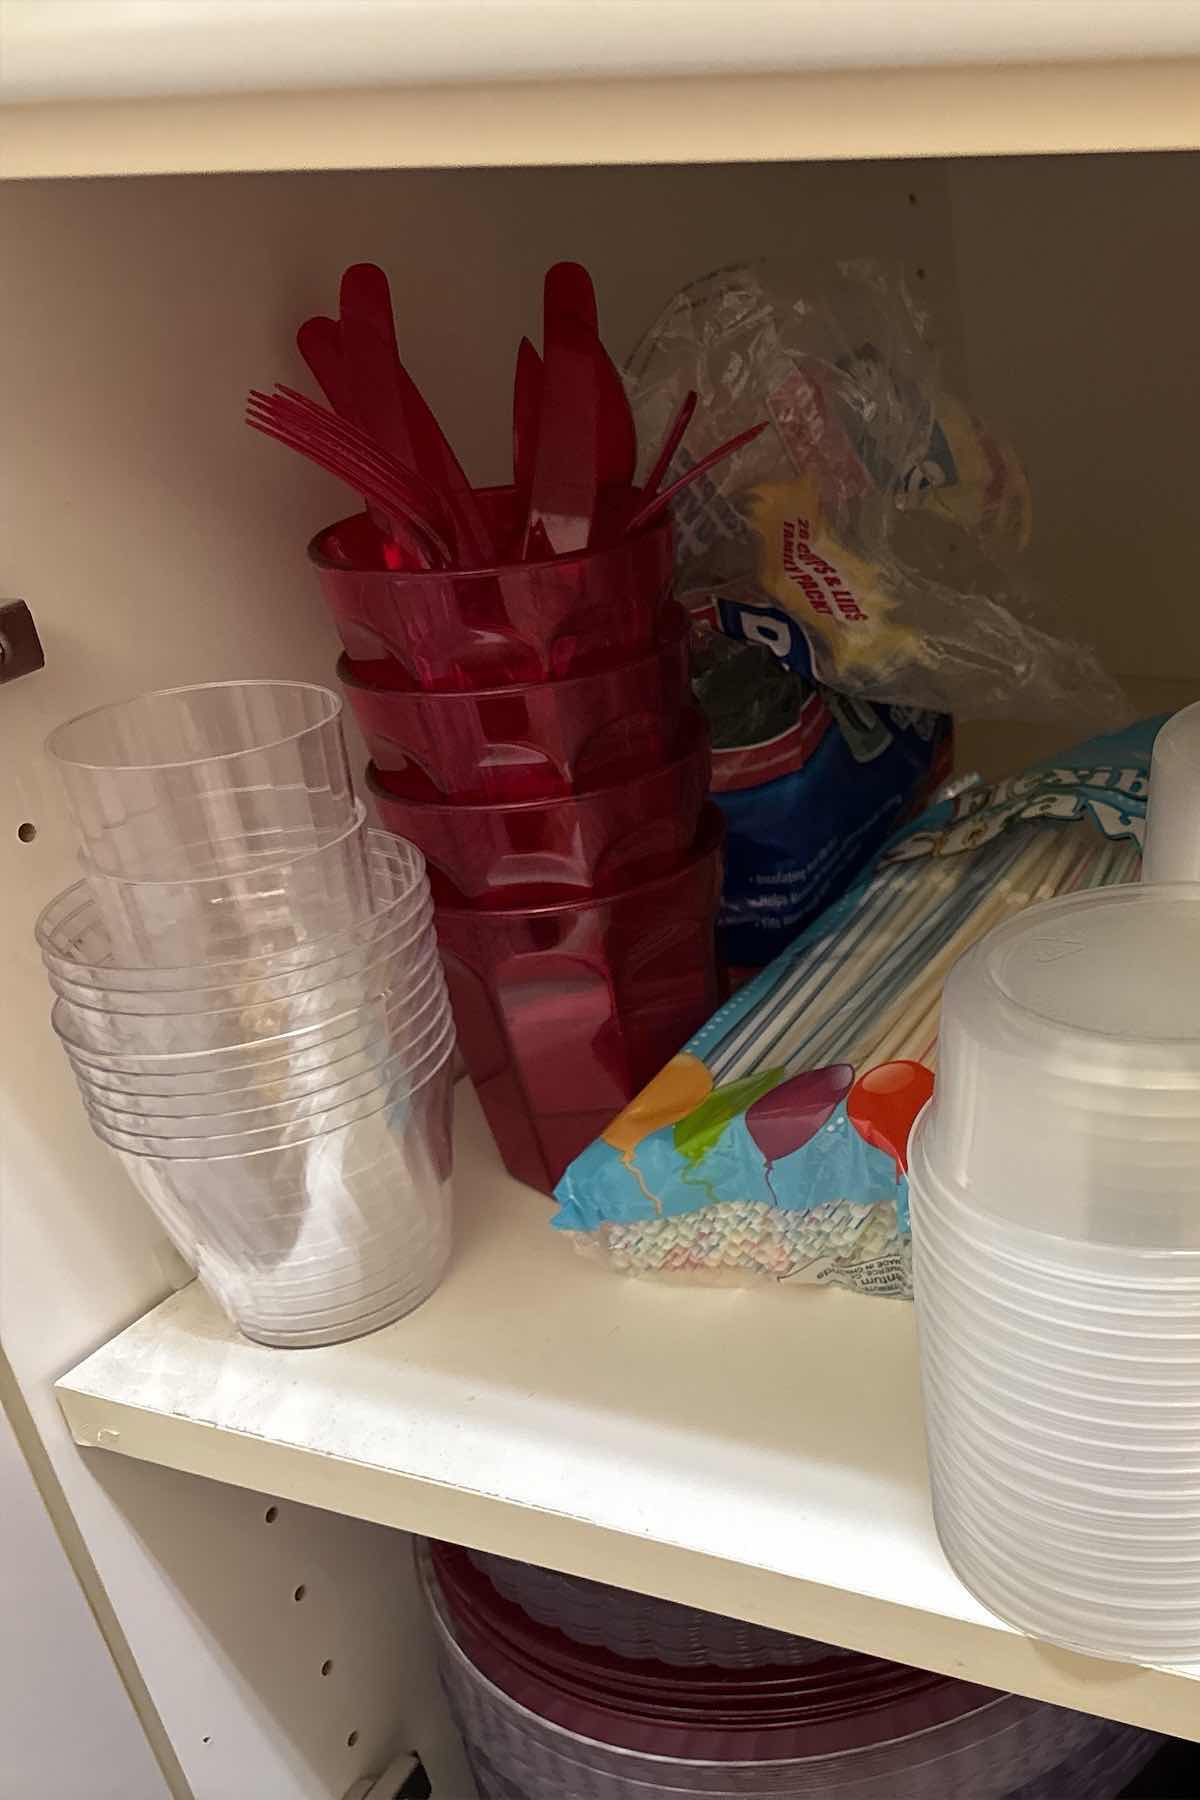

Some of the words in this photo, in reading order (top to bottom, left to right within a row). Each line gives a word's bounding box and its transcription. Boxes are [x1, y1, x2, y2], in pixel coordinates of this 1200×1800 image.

[783, 520, 805, 574] FAMILY
[797, 543, 837, 574] CUPS
[823, 575, 842, 587] &
[831, 590, 869, 621] LIDS
